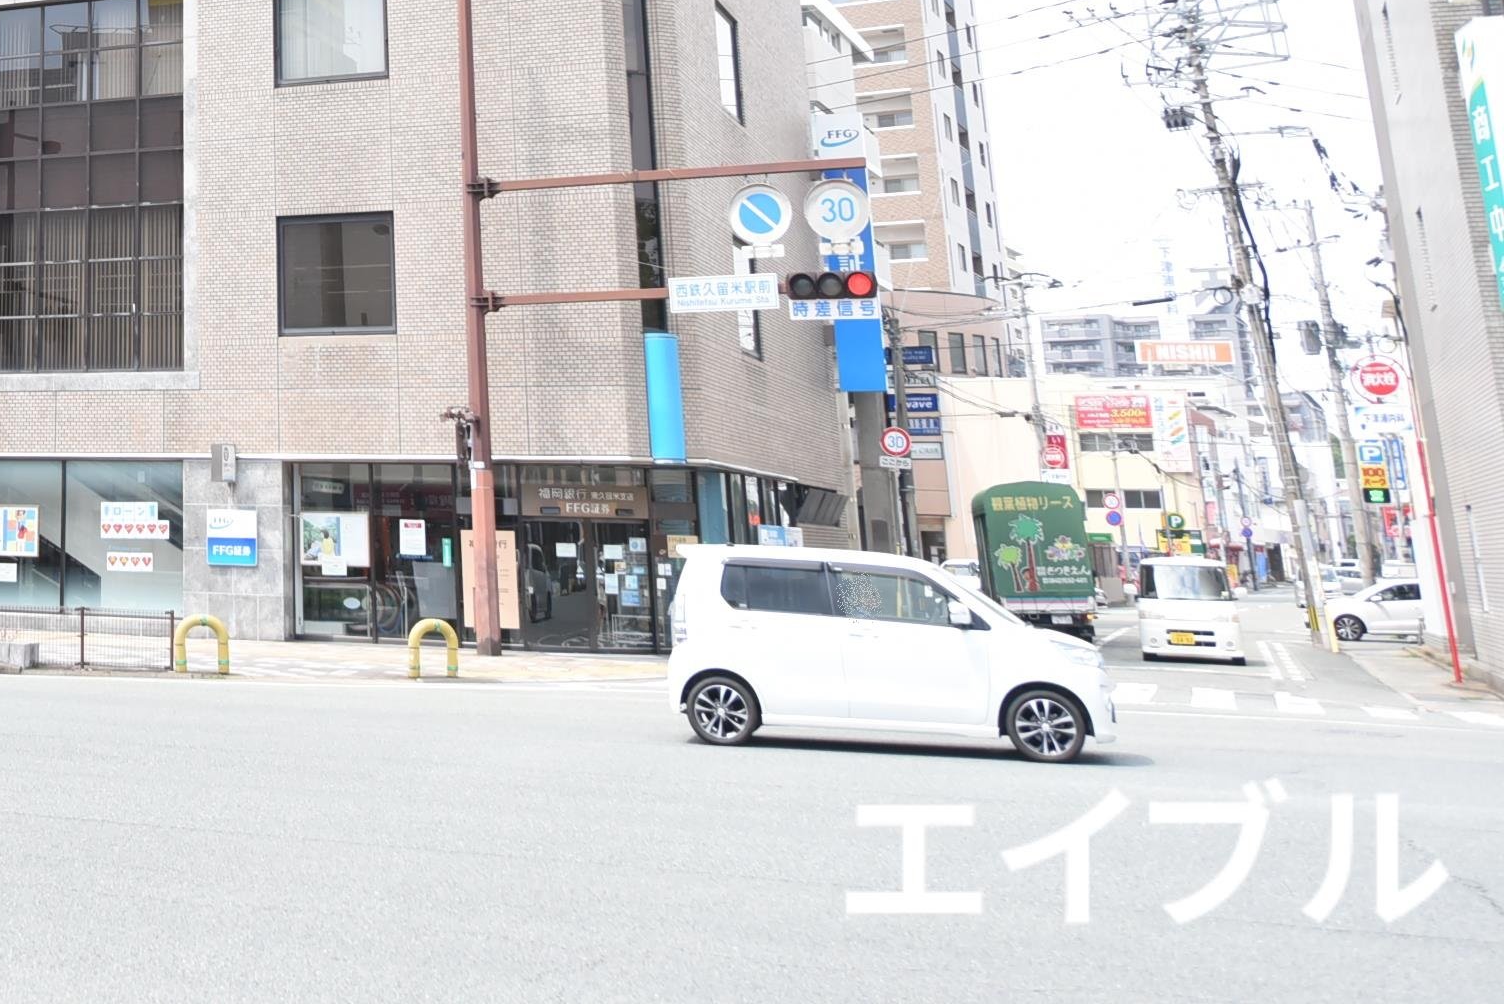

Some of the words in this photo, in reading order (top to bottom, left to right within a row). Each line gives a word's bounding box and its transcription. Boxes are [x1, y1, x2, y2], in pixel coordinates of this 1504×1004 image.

[827, 128, 853, 140] FFG
[1472, 104, 1504, 294] 商工中
[821, 196, 855, 223] 30
[675, 280, 772, 298] 西鉄久留米駅前
[792, 299, 876, 318] 時差信号
[888, 435, 904, 448] 30
[1362, 446, 1381, 461] P
[538, 487, 587, 500] 福岡銀行
[565, 502, 611, 514] FFG証券
[212, 545, 252, 557] FFG証券
